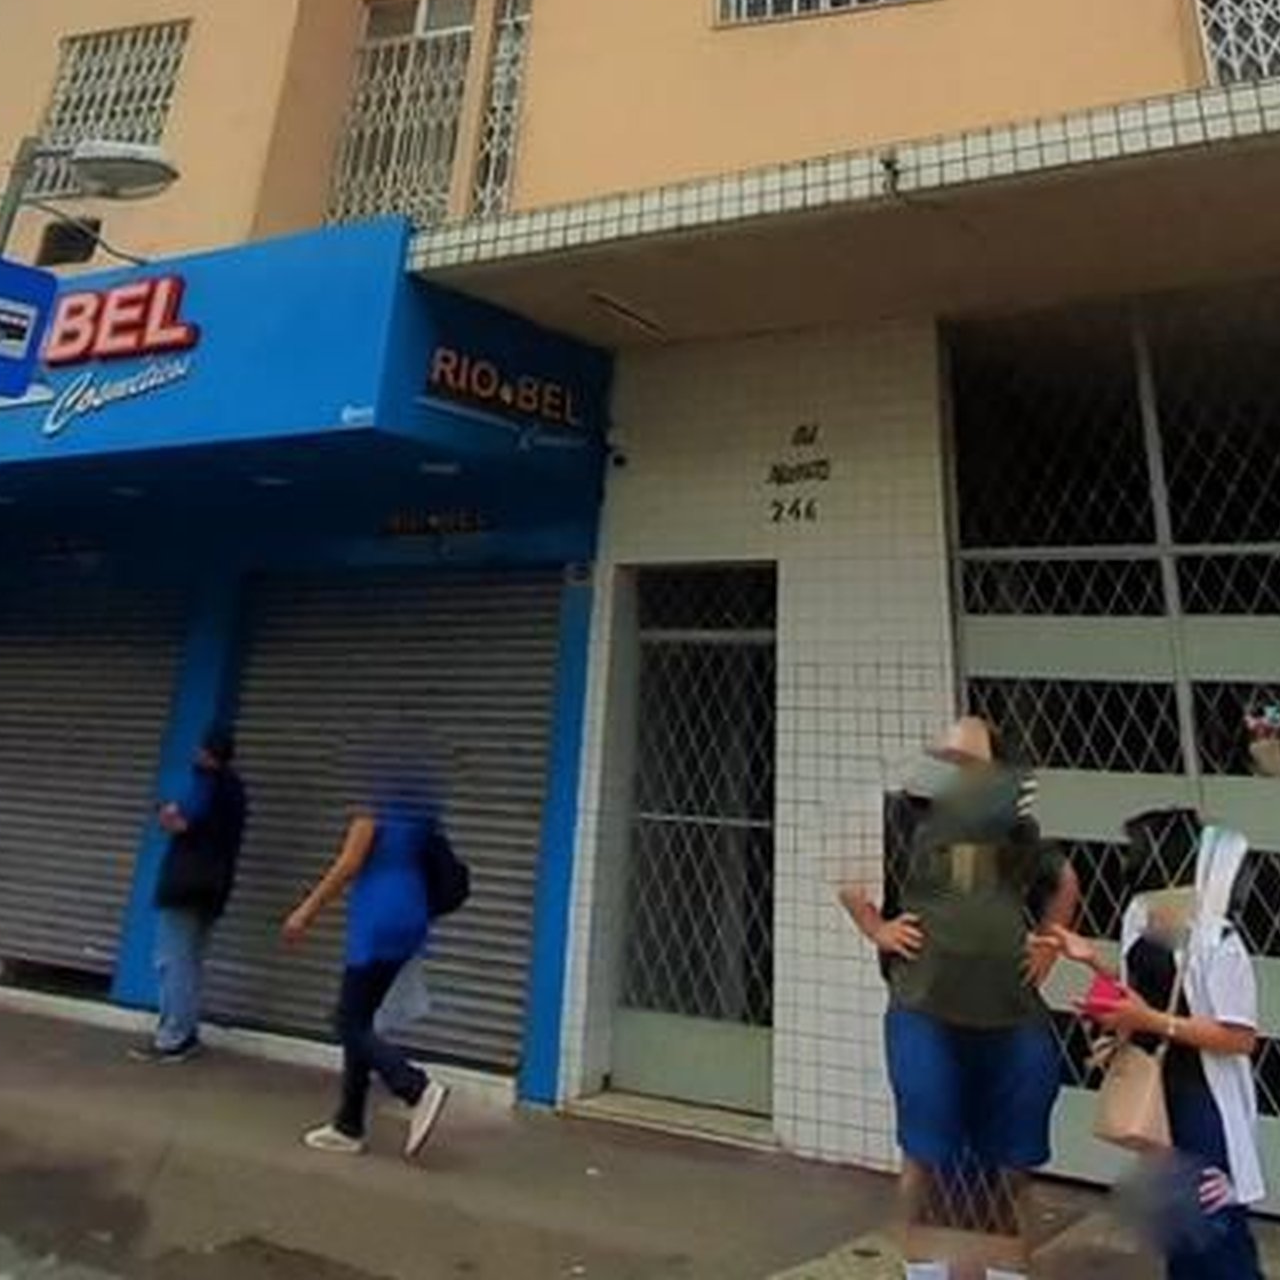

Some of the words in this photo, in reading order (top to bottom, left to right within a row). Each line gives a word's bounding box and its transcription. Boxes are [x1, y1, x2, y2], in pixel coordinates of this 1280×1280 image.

[44, 276, 197, 368] BEL
[431, 346, 499, 399] RIO
[516, 376, 583, 428] BEL
